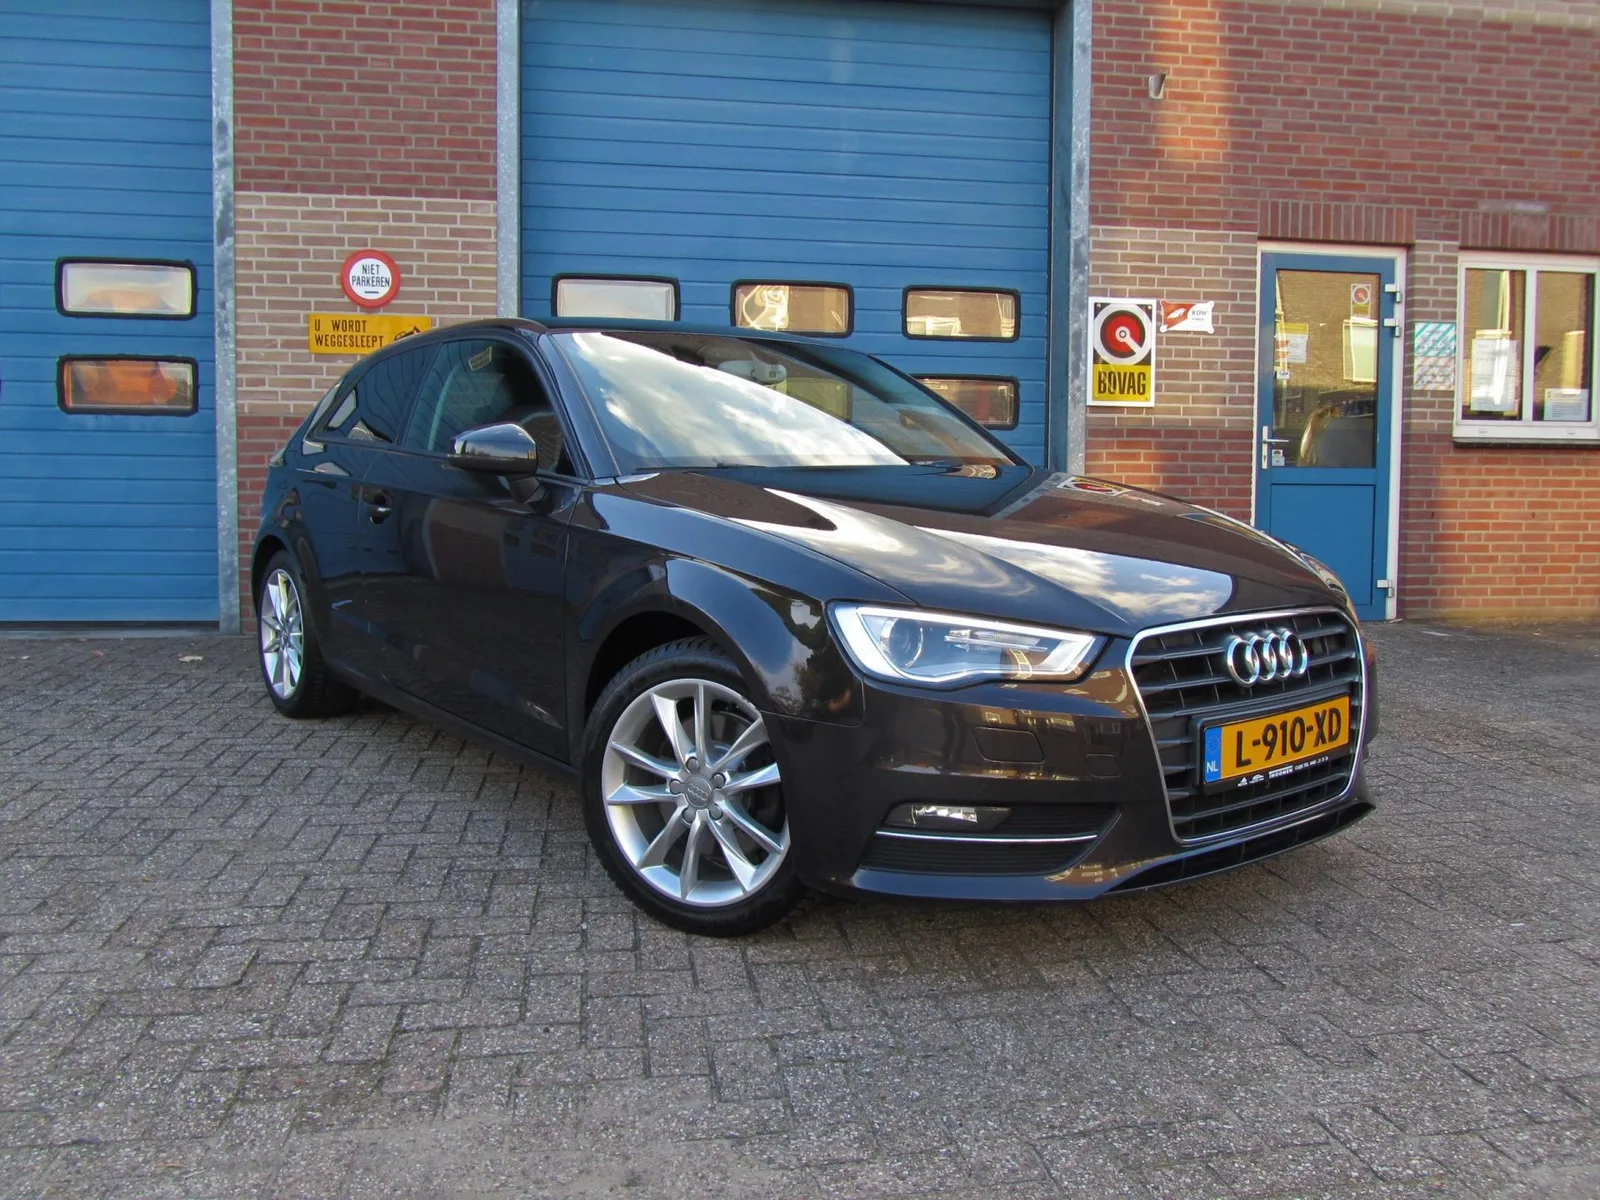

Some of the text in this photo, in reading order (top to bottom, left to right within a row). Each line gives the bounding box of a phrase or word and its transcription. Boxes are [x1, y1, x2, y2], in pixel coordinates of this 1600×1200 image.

[361, 264, 380, 275] NIET
[351, 275, 390, 287] PARKEREN
[314, 319, 367, 333] U WORDT
[314, 334, 384, 348] WEGGESLEEPT
[1097, 371, 1146, 395] BOVAG
[1206, 761, 1219, 773] NL
[1235, 707, 1342, 768] L-910-XD
